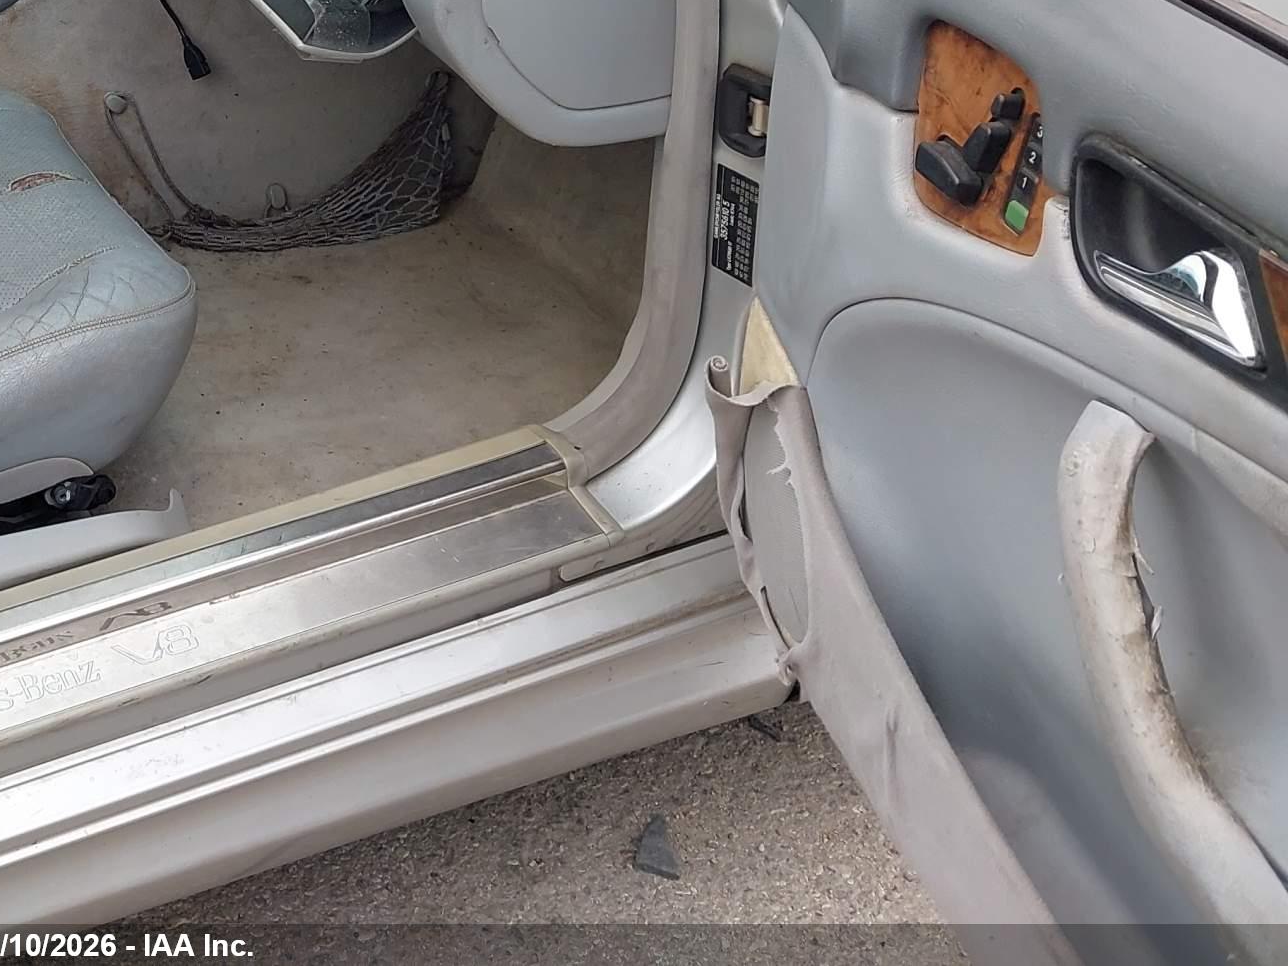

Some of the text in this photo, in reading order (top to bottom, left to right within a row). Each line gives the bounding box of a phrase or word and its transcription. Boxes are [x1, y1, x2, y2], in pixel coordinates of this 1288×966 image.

[1028, 151, 1037, 164] 2
[1022, 176, 1028, 189] 1
[111, 622, 200, 666] V8
